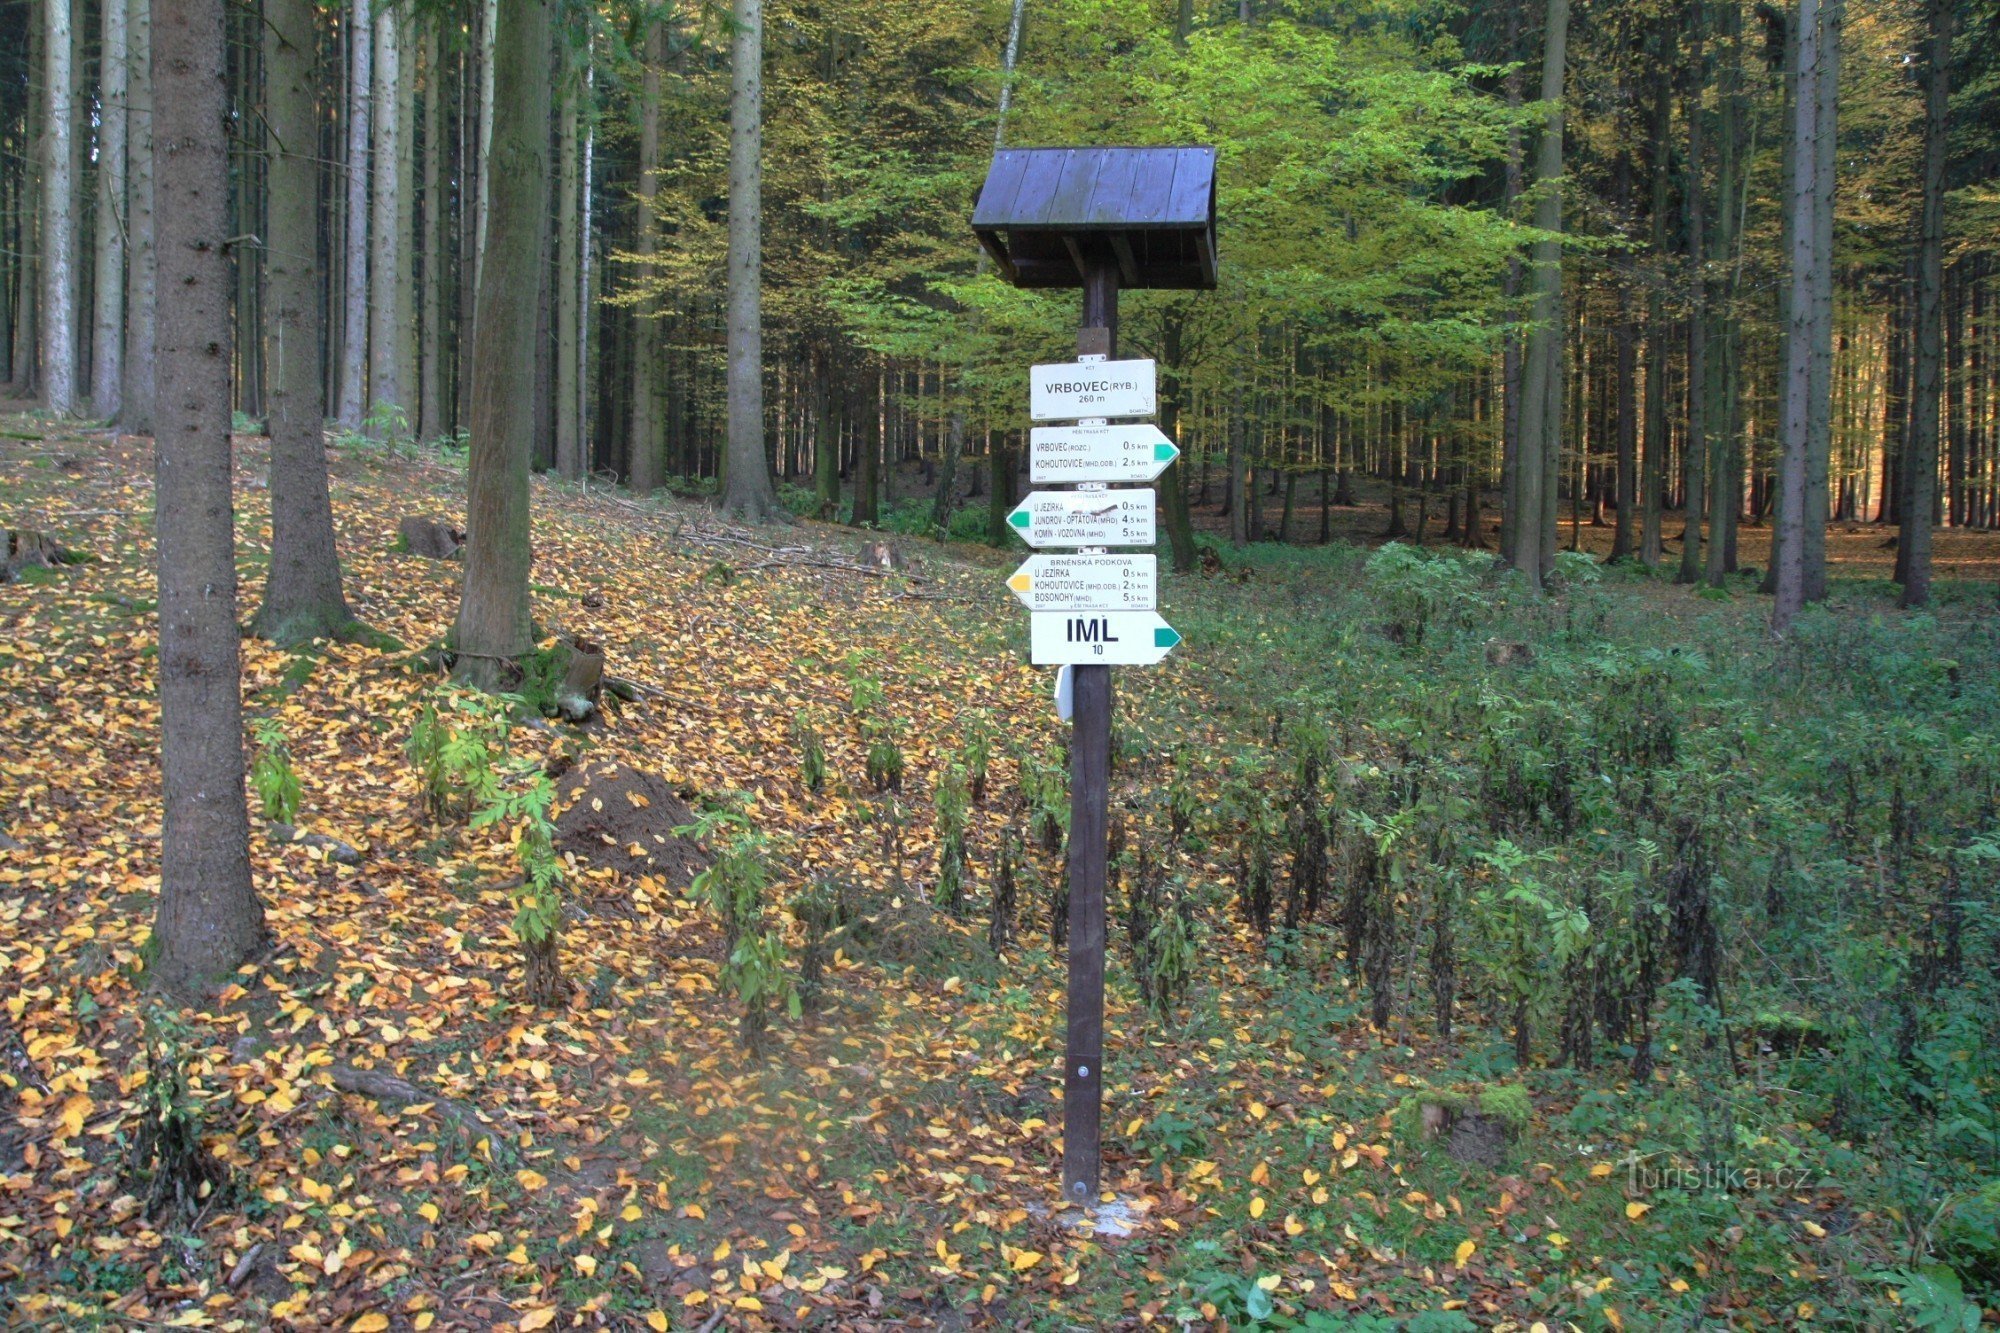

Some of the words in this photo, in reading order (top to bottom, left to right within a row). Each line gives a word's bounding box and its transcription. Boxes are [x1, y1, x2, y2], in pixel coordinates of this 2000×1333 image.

[1034, 503, 1039, 512] U
[1034, 515, 1062, 525] JUNDROV
[1034, 528, 1053, 538] KOMÍN
[1058, 529, 1085, 538] VOZOVNA
[1042, 568, 1070, 577] JEZÍRKA
[1035, 581, 1084, 590] KOHOUTOVICE
[1067, 619, 1119, 642] IML
[1092, 645, 1103, 655] 10
